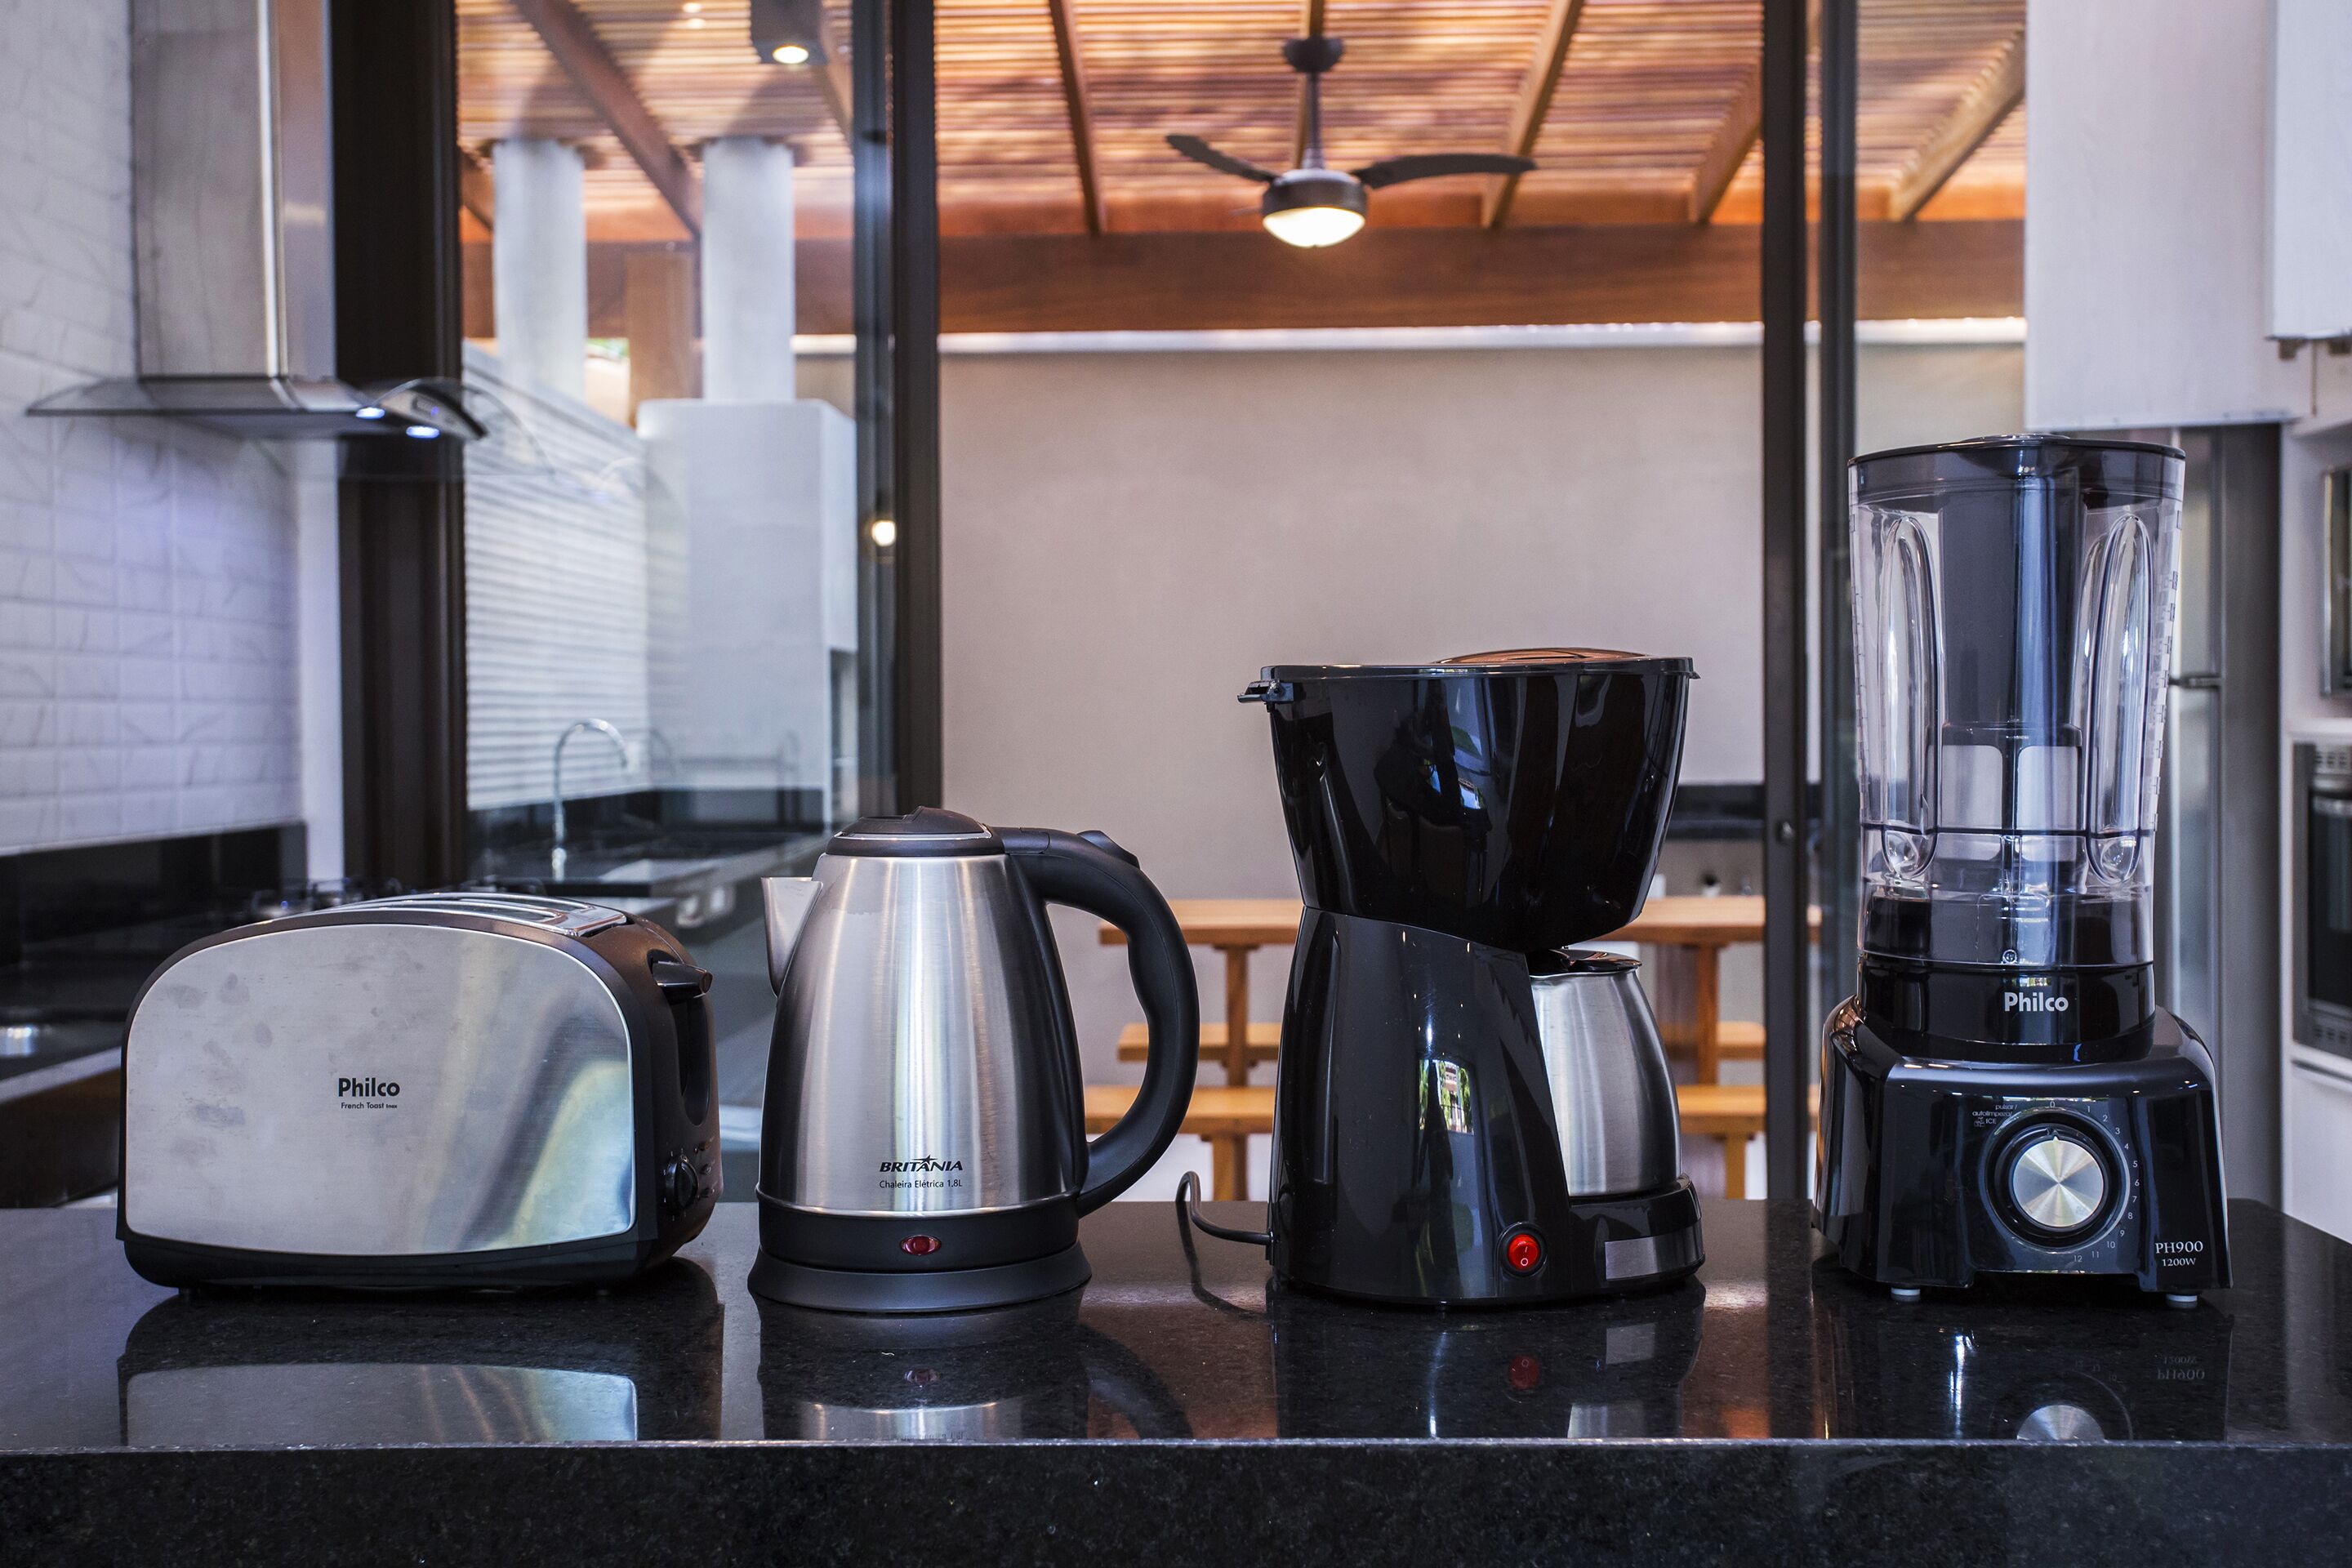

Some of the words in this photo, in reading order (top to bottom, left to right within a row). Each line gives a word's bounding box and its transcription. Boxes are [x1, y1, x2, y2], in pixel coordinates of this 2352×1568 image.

[2004, 991, 2069, 1012] Philco
[338, 1077, 400, 1097] Philco
[2115, 1127, 2121, 1135] 3
[879, 1180, 912, 1188] Chaleira
[915, 1179, 944, 1188] Elétrica
[947, 1178, 963, 1187] 1.8L
[2155, 1241, 2203, 1254] PH900
[2074, 1254, 2082, 1263] 12
[2091, 1250, 2100, 1258] 11
[2162, 1258, 2196, 1266] 1200W
